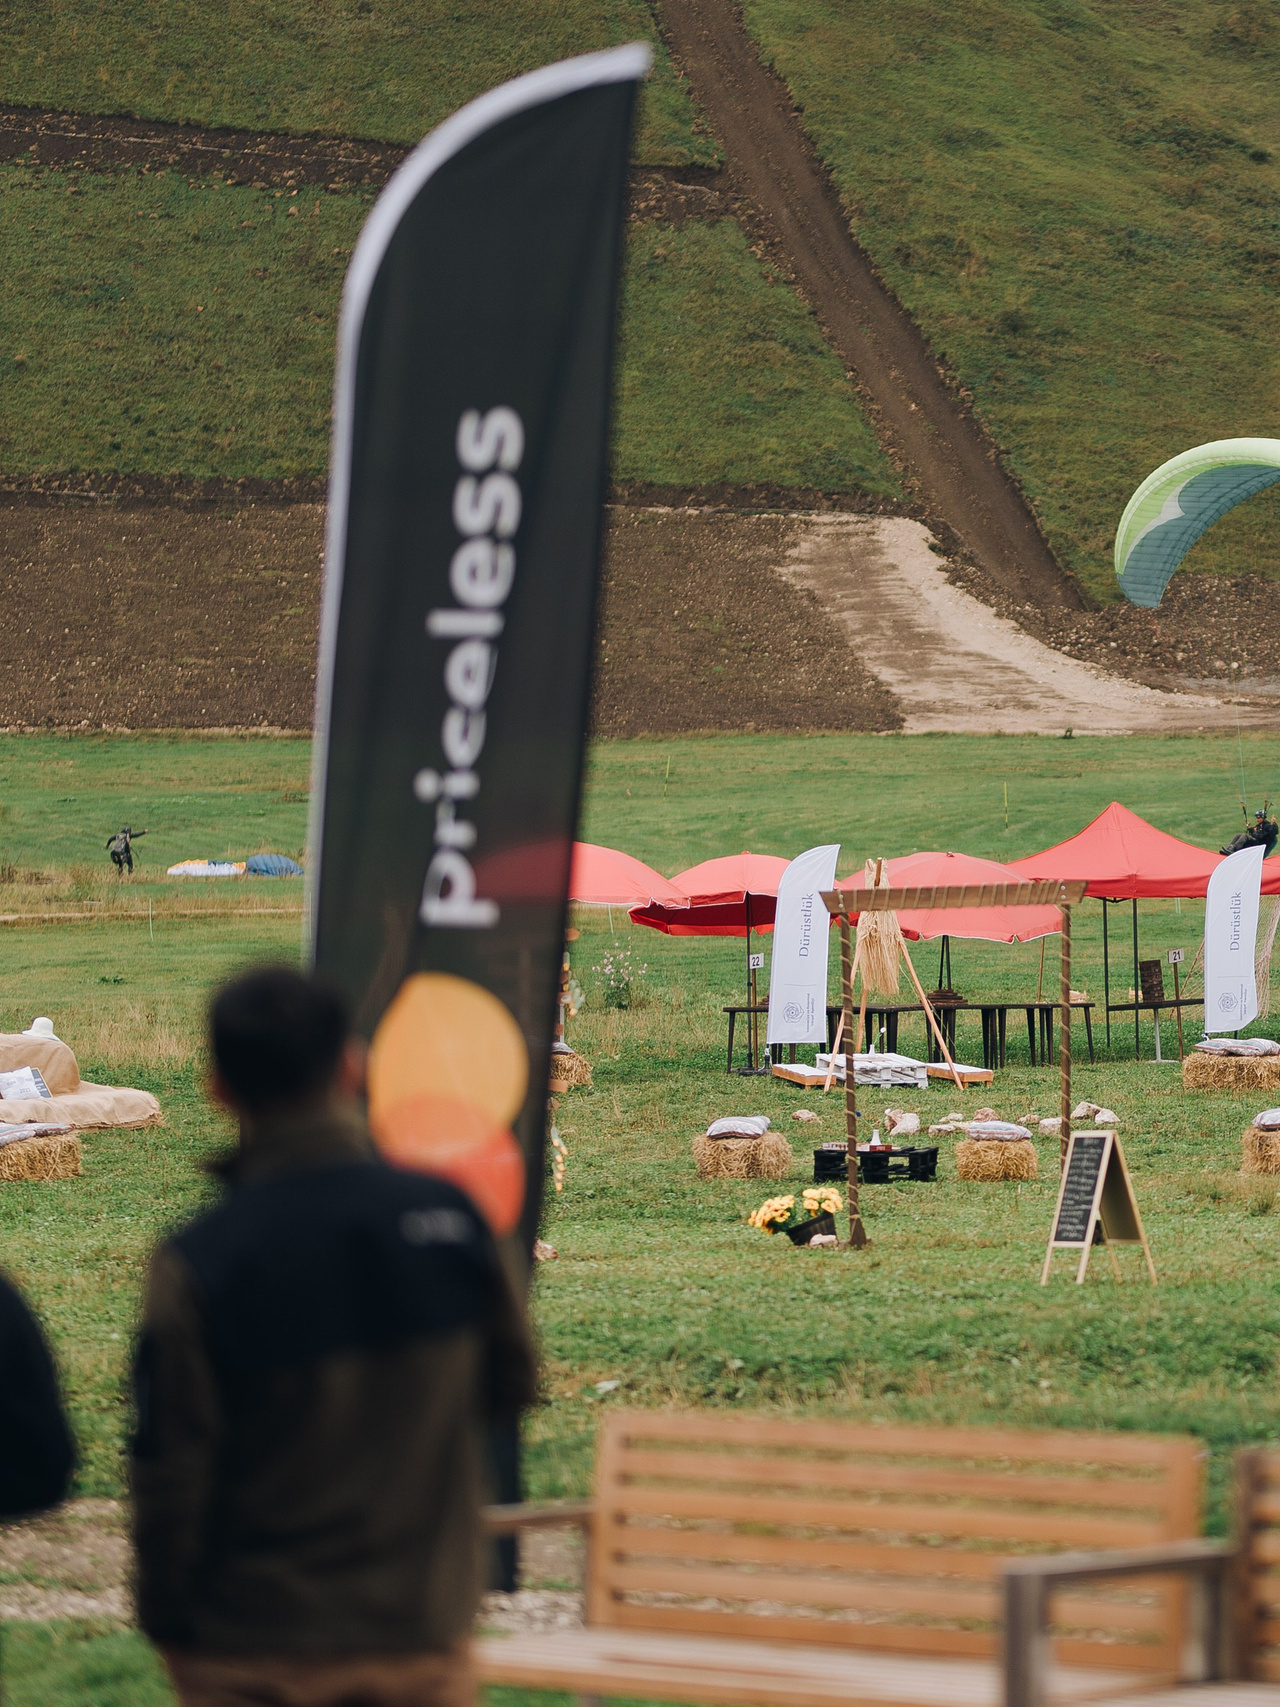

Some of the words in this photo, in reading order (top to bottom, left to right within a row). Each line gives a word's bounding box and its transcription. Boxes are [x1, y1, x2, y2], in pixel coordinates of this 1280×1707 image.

[413, 406, 526, 929] priceless
[799, 893, 814, 957] Dürüstlük
[1229, 891, 1241, 951] Dürüstlük
[752, 956, 760, 967] 22
[1172, 951, 1181, 961] 21
